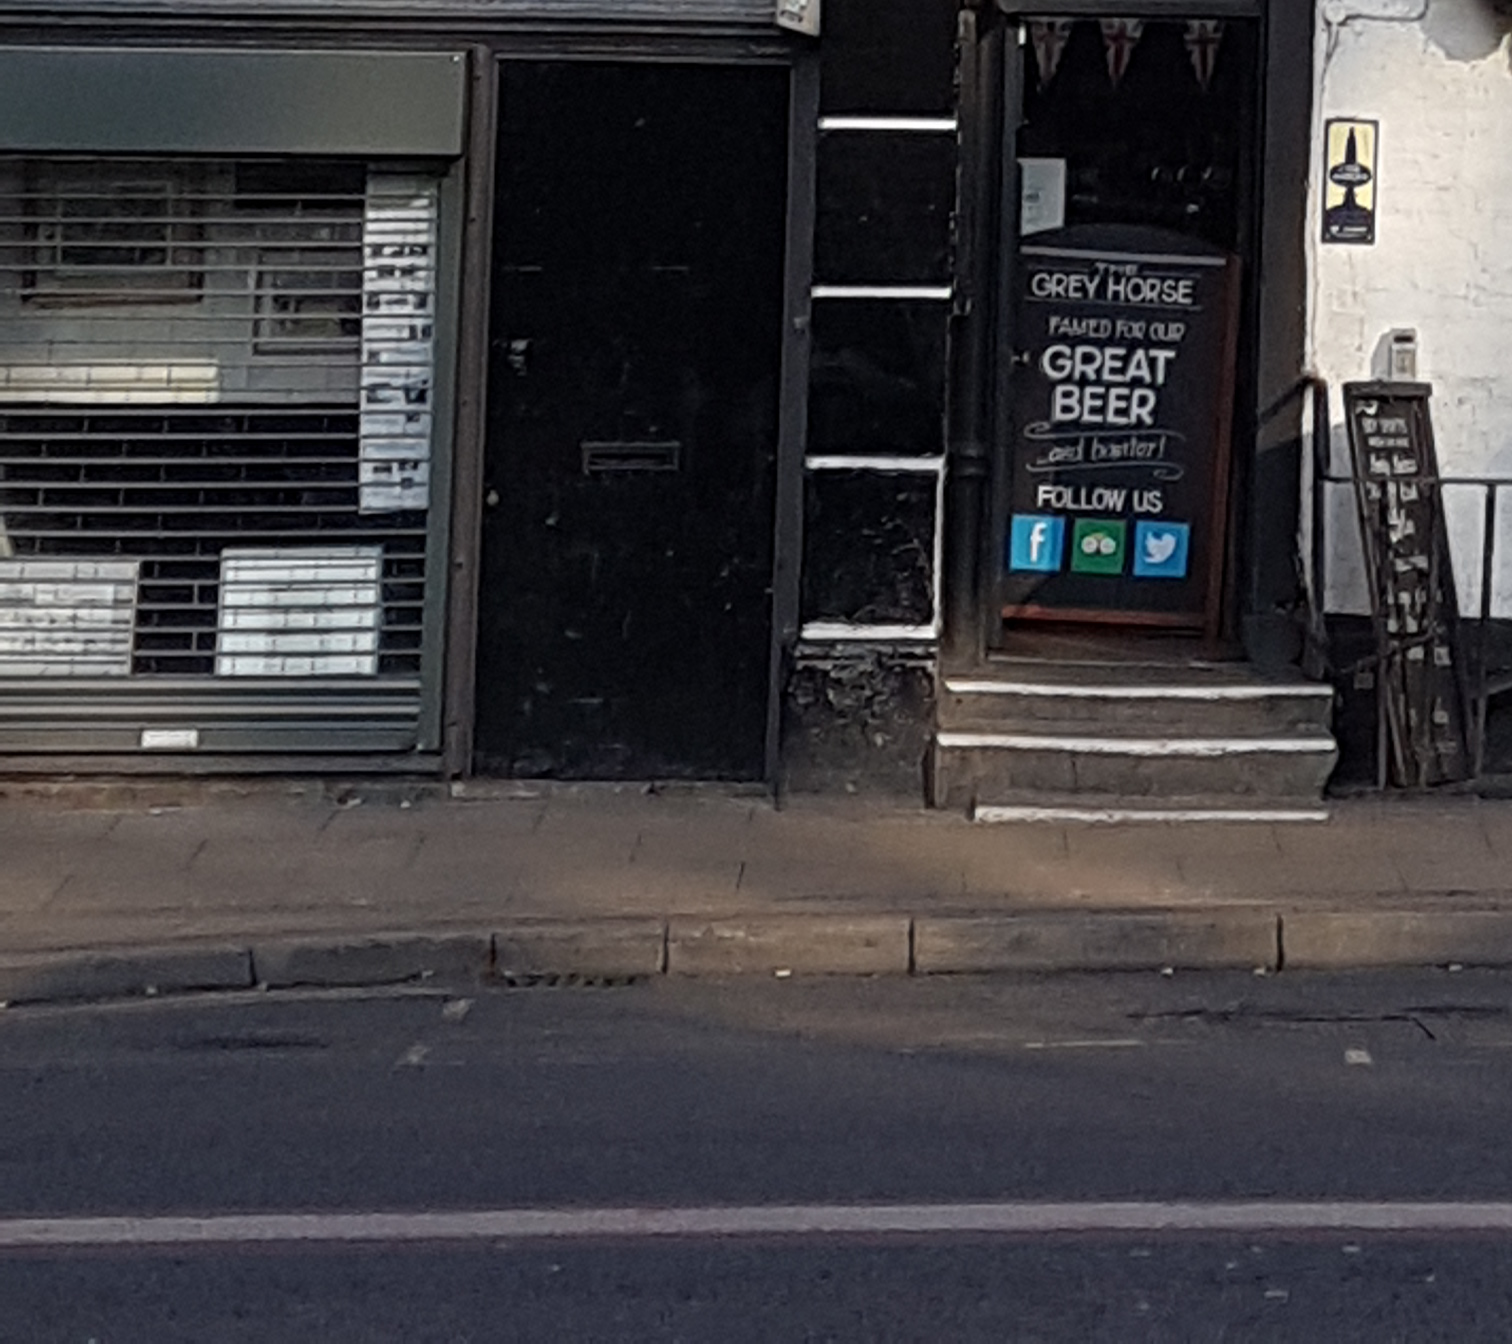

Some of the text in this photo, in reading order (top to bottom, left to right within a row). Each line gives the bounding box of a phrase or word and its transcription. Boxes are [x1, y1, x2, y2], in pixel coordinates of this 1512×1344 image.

[1031, 272, 1194, 305] GREY HORSE
[1115, 320, 1146, 340] FOR
[1042, 345, 1175, 385] GREAT
[1052, 385, 1157, 425] BEER
[1037, 485, 1164, 513] FOLLOW US
